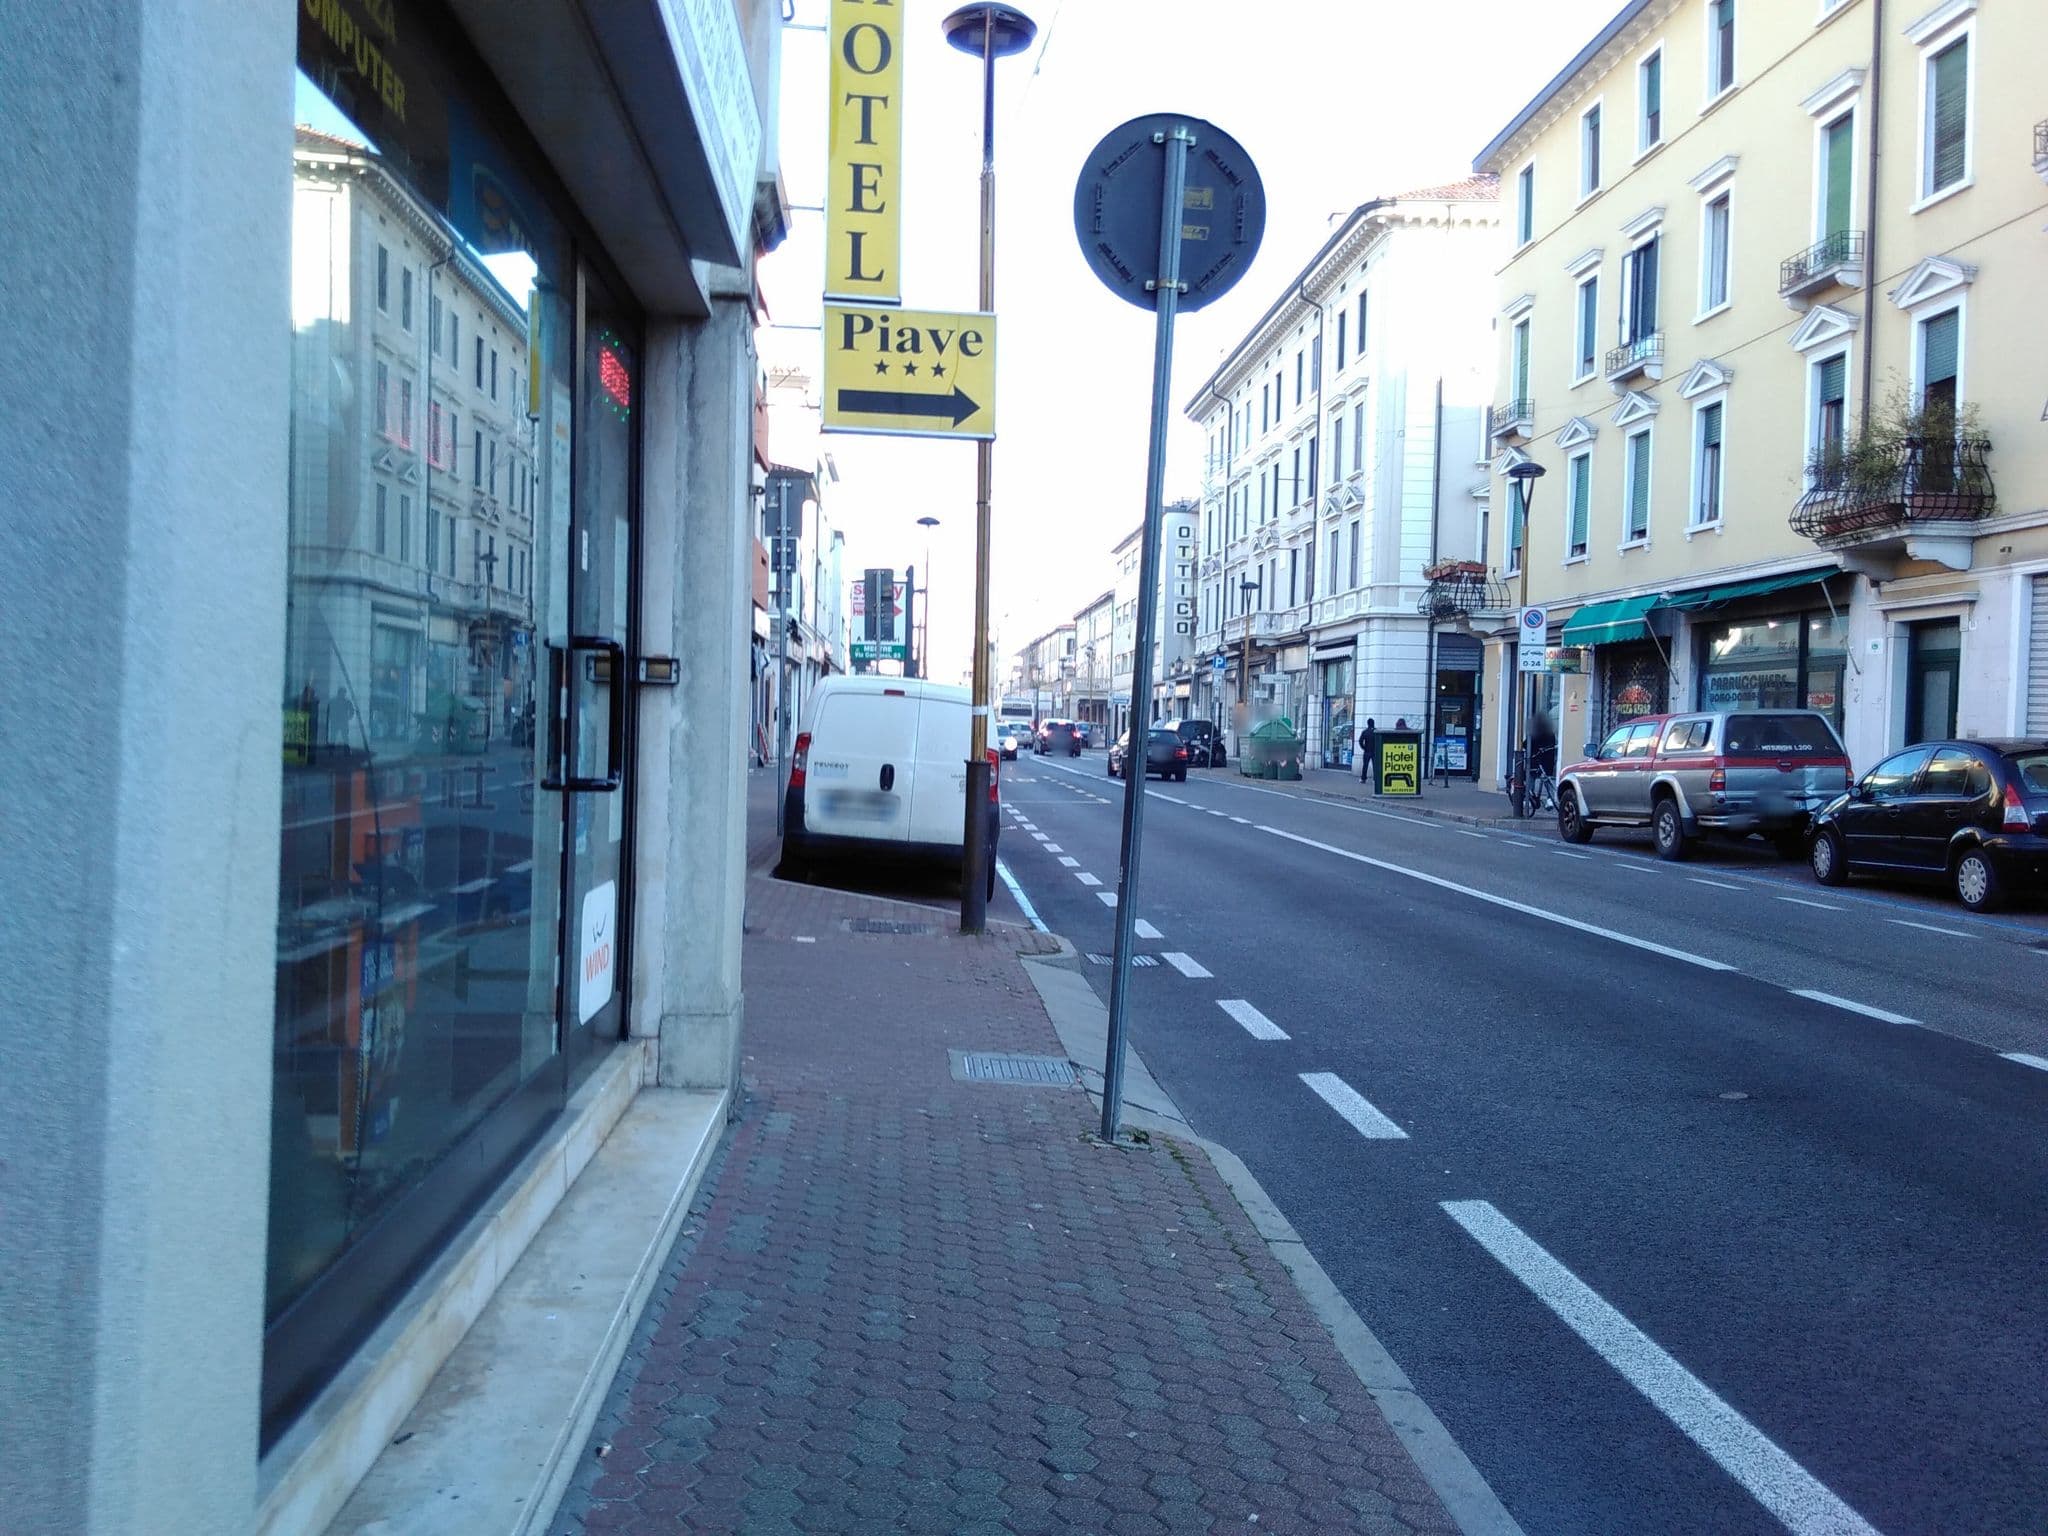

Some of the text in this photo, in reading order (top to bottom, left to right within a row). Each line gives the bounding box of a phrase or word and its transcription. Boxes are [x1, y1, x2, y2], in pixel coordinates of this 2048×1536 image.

[841, 0, 894, 283] OTEL
[839, 312, 984, 357] Piave
[1177, 526, 1191, 634] OTTICO
[814, 761, 849, 769] PEUGEOT
[1384, 762, 1414, 772] Piave
[1385, 751, 1414, 762] Hotel
[585, 943, 610, 984] WIND
